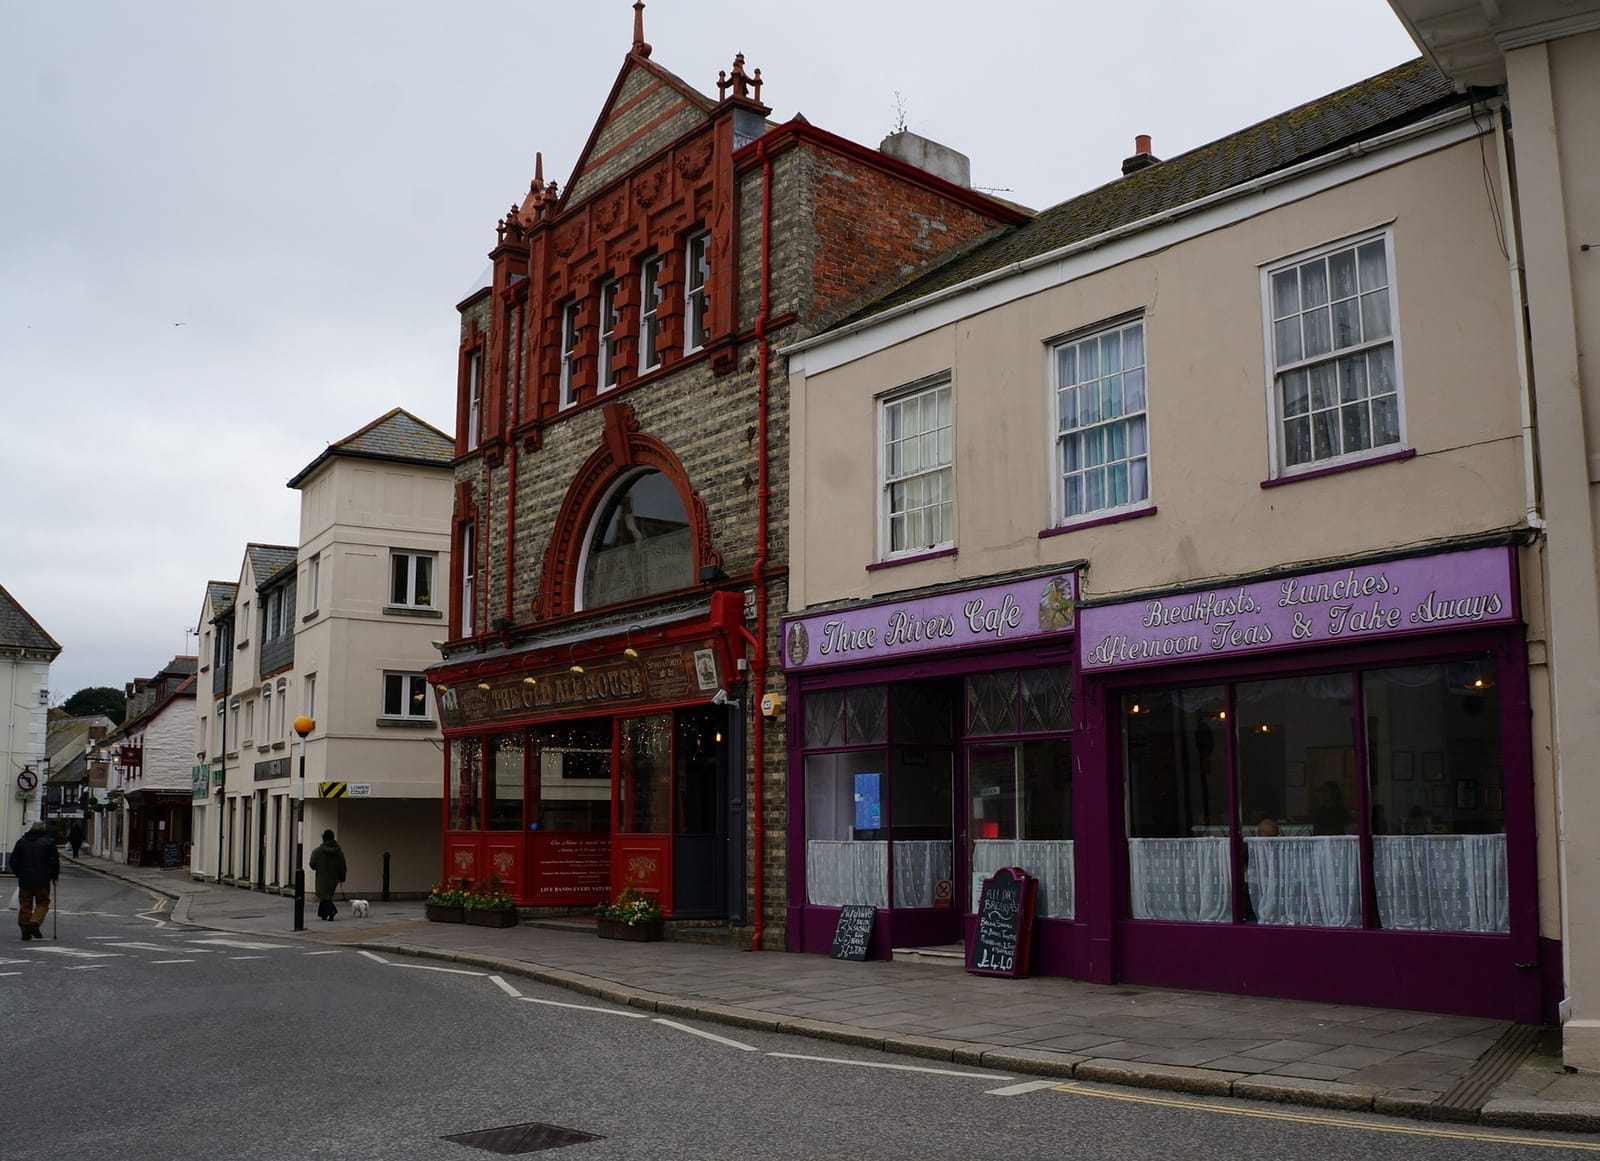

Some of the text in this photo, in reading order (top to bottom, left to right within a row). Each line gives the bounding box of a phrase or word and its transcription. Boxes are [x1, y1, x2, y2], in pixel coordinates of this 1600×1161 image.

[820, 593, 1022, 655] Three Rivers Cafe
[1143, 569, 1400, 628] Breakfasts, Lunches,
[1087, 591, 1503, 666] Afternoon Teas & Take Aways
[492, 687, 521, 712] THE
[521, 681, 553, 708] OLD
[555, 676, 585, 704] ALE
[585, 668, 643, 700] HOUSE
[986, 888, 1000, 900] ALL
